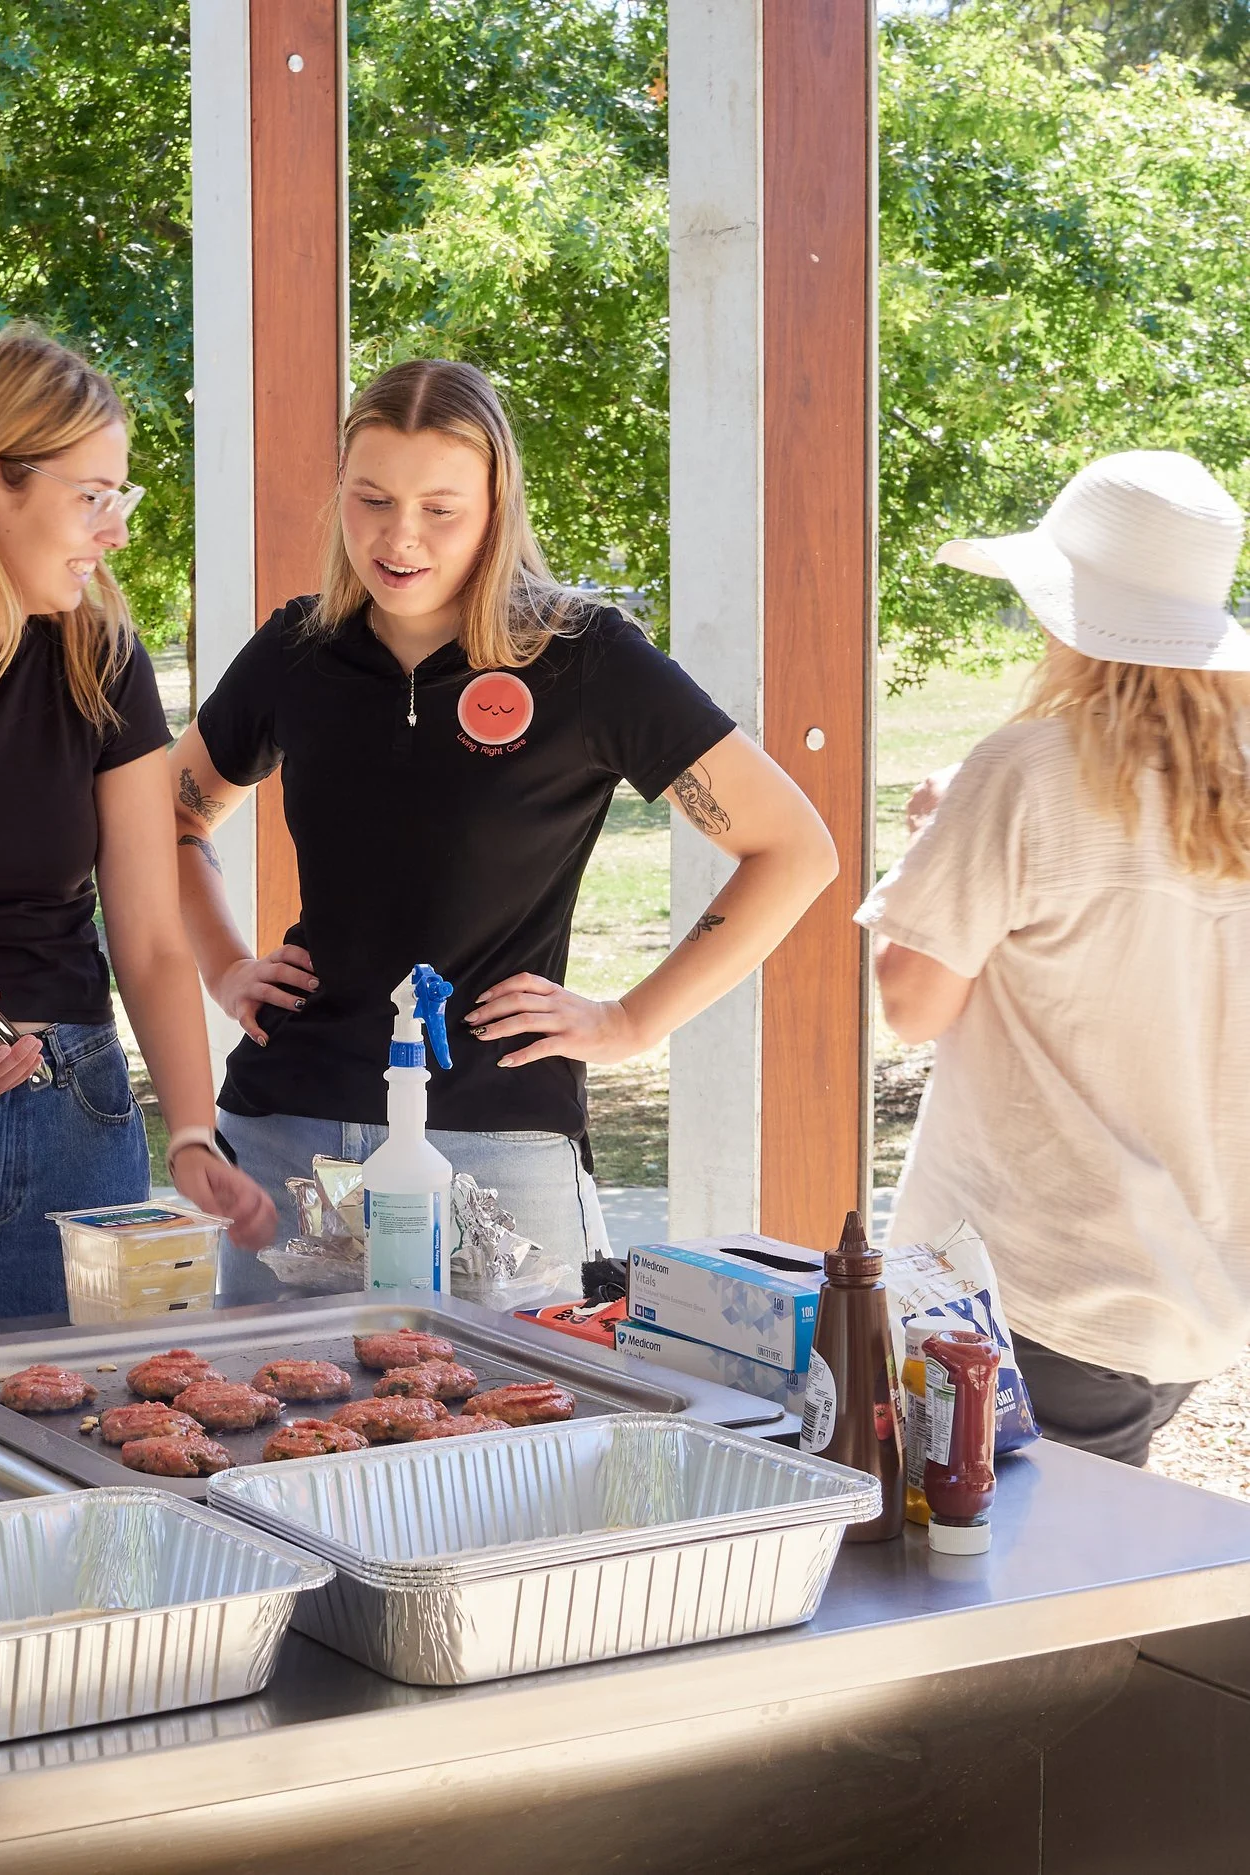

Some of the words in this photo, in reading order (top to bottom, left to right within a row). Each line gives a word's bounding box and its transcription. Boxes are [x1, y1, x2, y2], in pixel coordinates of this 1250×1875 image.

[456, 731, 478, 753] Living
[480, 745, 503, 757] Right
[506, 738, 527, 753] Care
[641, 1257, 669, 1275] Medicom
[635, 1270, 656, 1287] Vitals
[773, 1297, 784, 1311] 100
[801, 1306, 814, 1318] 100
[628, 1335, 661, 1352] Medicom
[786, 1373, 799, 1386] 100
[996, 1387, 1015, 1407] SALT
